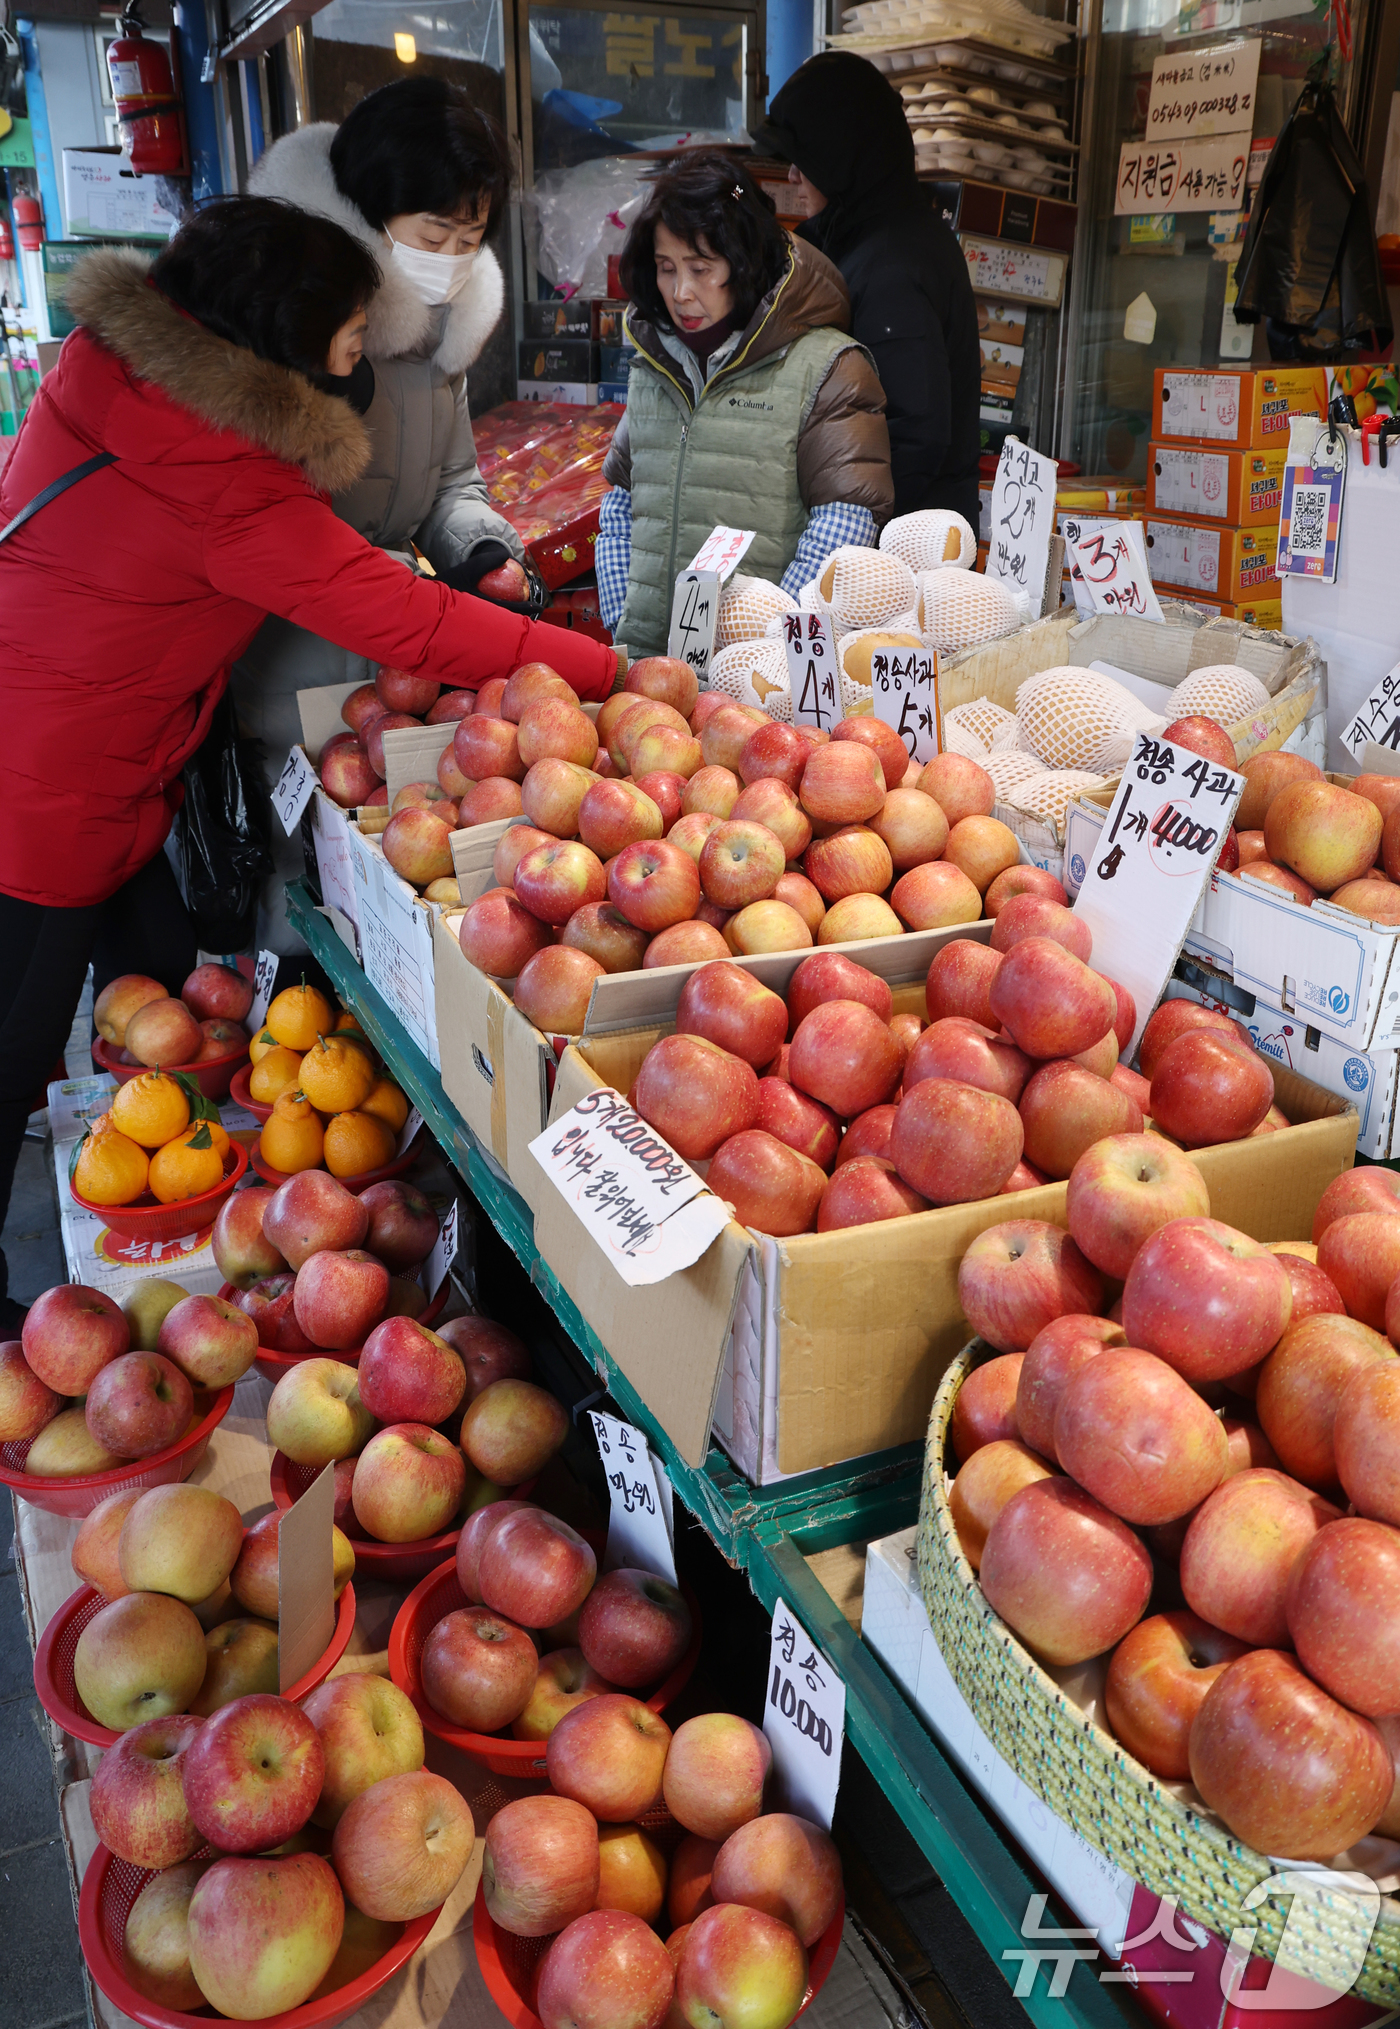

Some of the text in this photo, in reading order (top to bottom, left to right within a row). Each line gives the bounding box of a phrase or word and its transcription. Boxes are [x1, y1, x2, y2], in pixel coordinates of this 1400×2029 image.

[1261, 398, 1289, 416] 서귀포
[1250, 477, 1278, 493] 서귀포
[1240, 553, 1268, 571] 서귀포
[1306, 561, 1322, 572] zero
[784, 614, 827, 657] 청송
[873, 653, 937, 692] 청송사과
[1133, 734, 1239, 806] 청송 사과
[594, 1415, 637, 1464] 청송
[774, 1617, 827, 1692] 청송
